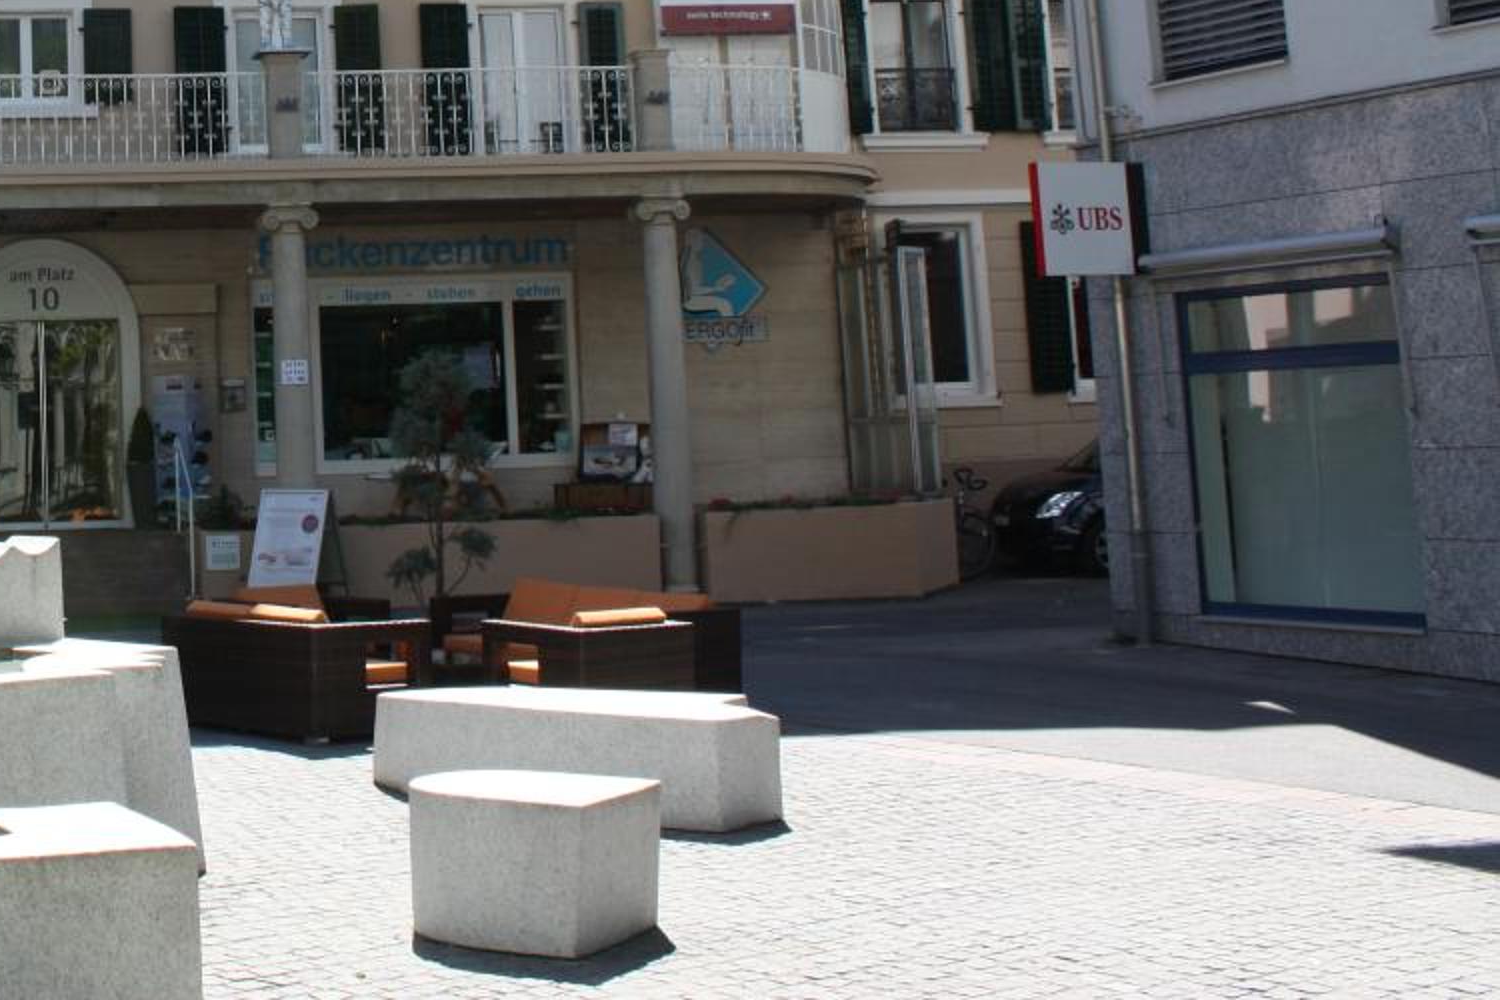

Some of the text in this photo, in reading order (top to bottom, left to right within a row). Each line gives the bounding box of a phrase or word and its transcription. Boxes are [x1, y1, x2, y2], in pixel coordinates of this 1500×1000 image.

[1077, 206, 1123, 231] UBS
[8, 266, 75, 283] am Platz
[28, 286, 61, 311] 10
